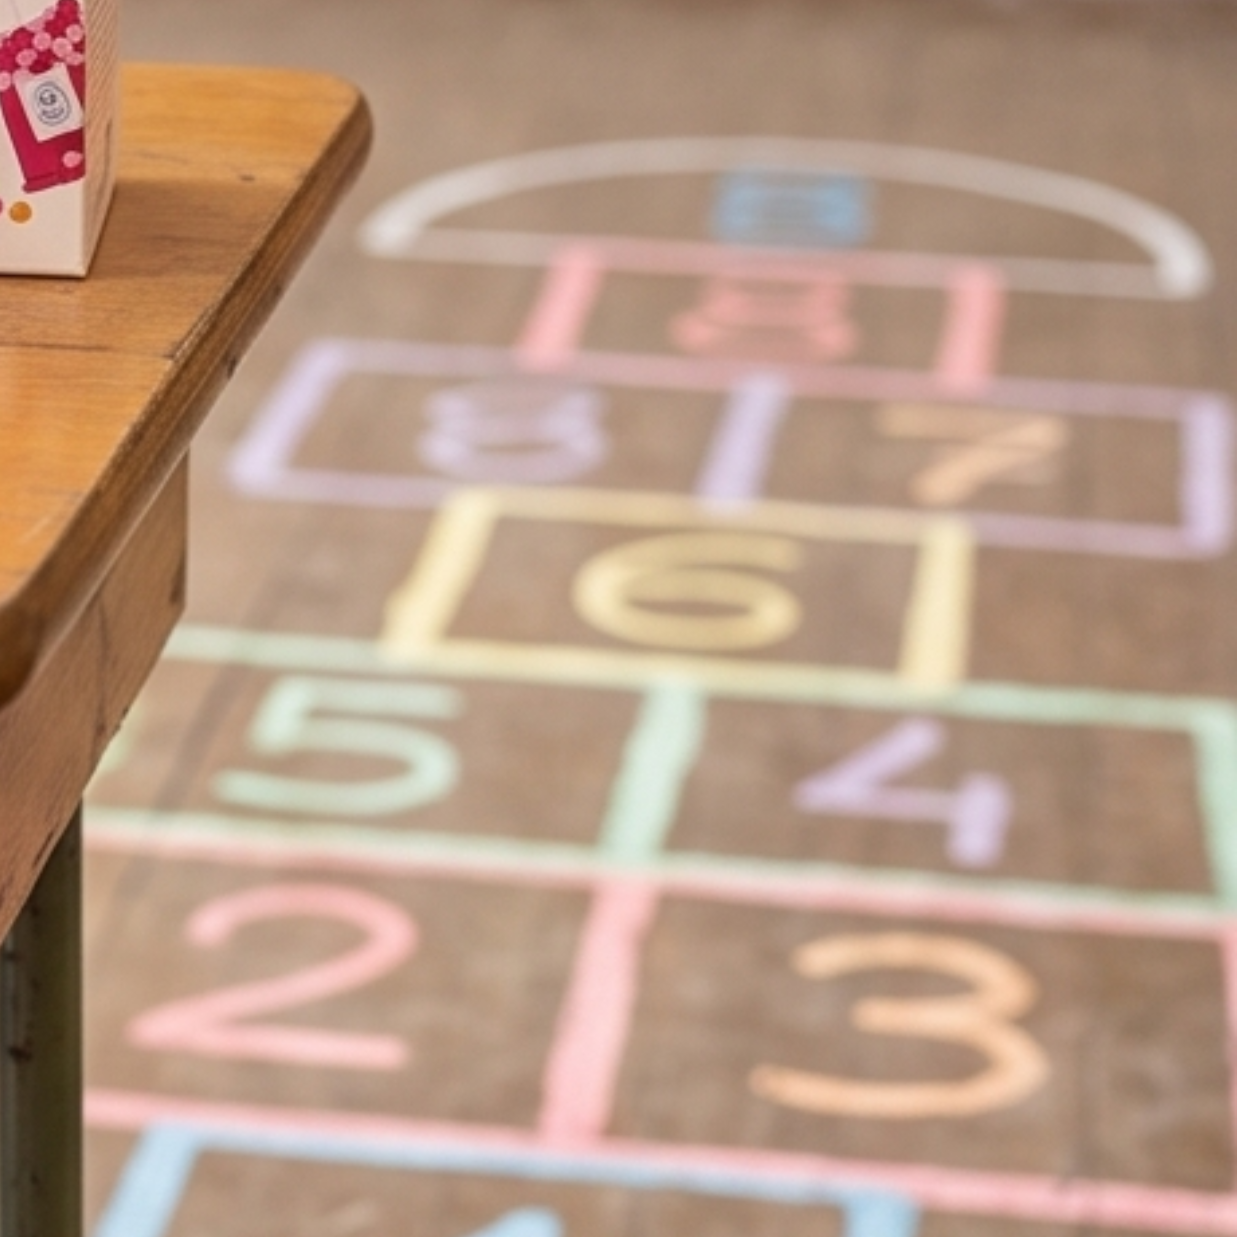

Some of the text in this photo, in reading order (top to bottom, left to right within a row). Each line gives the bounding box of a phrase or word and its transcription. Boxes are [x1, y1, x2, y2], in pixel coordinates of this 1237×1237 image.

[874, 400, 1068, 504] 7
[572, 530, 802, 651] 6
[215, 677, 1012, 865] 5 4
[126, 882, 1051, 1120] 2 3
